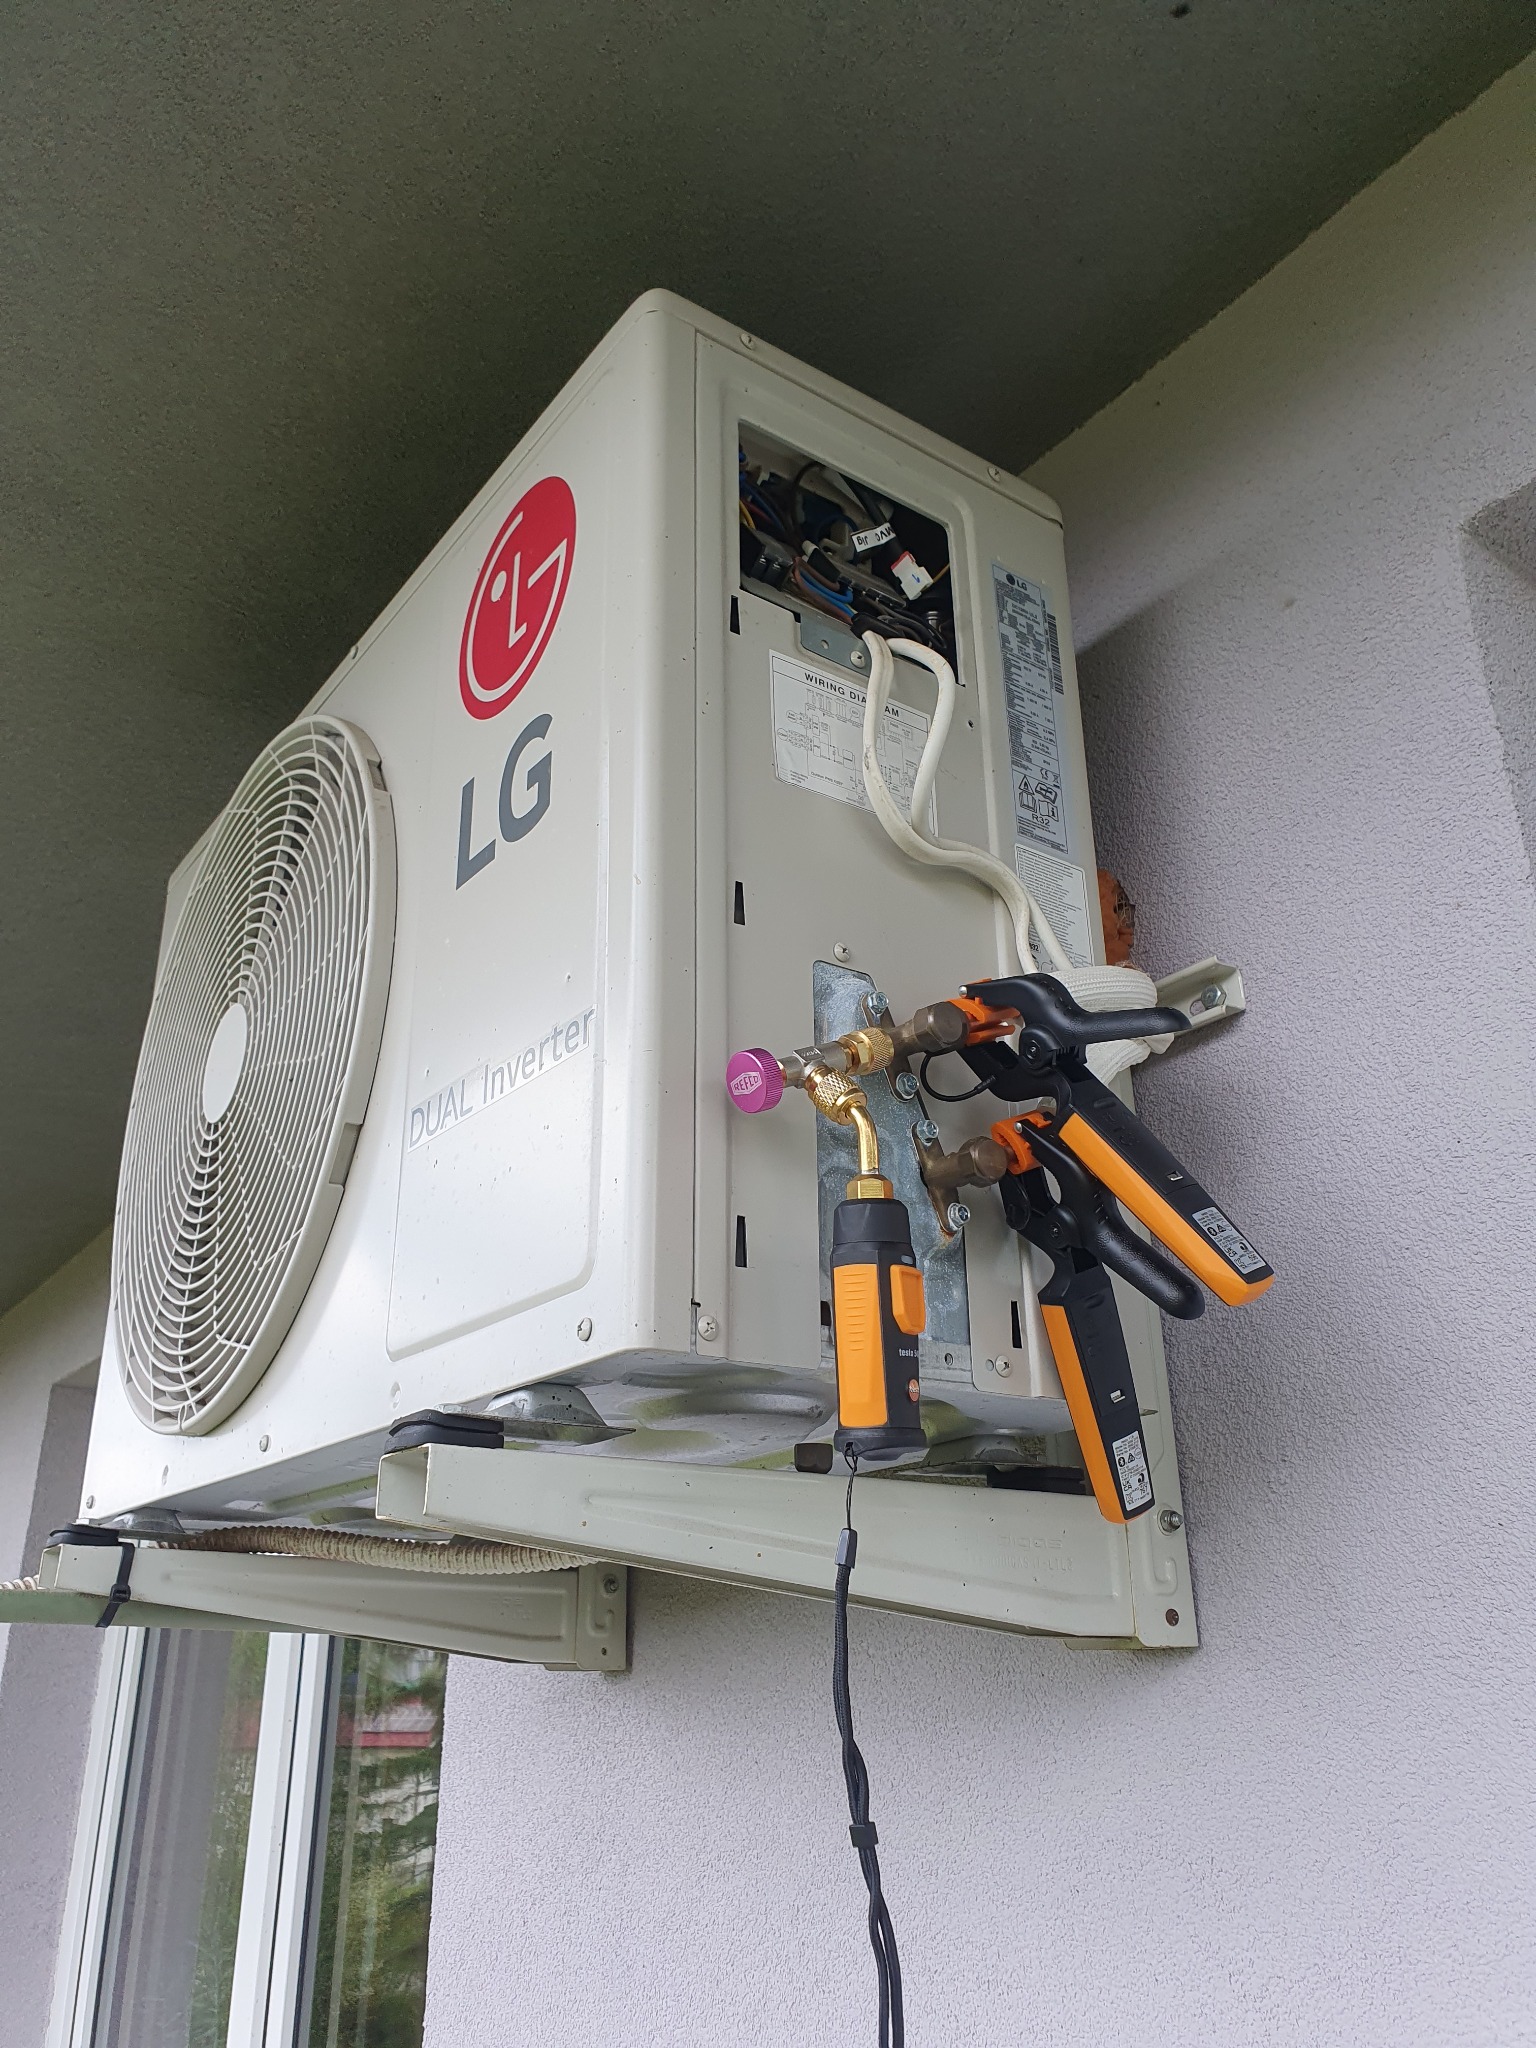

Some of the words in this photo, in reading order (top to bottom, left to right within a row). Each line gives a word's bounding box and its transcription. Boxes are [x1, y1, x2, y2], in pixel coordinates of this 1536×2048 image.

[804, 673, 845, 696] WIRING
[849, 690, 899, 717] DIAAM
[455, 713, 554, 889] LG
[1031, 814, 1050, 827] R32
[409, 1082, 474, 1149] DUAL
[482, 1007, 595, 1102] Inverter
[734, 1075, 759, 1091] REFCO
